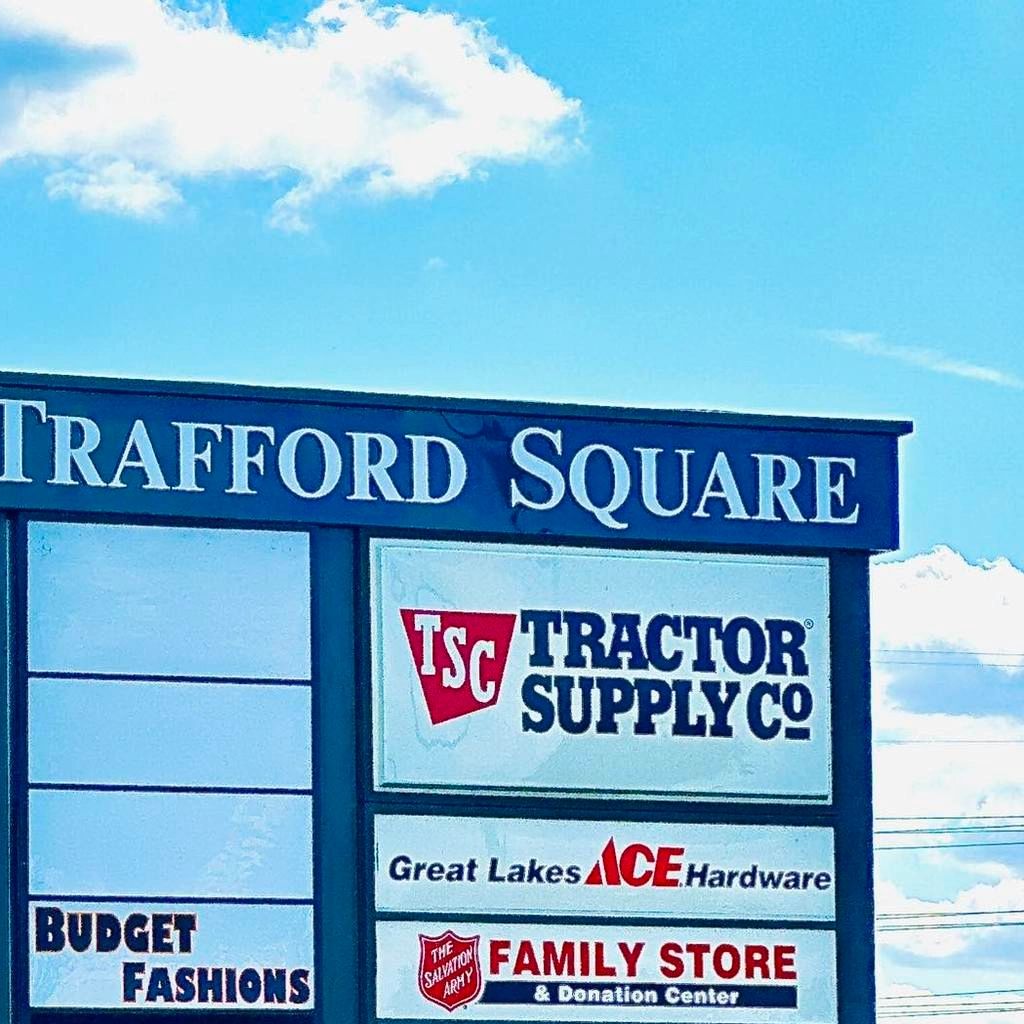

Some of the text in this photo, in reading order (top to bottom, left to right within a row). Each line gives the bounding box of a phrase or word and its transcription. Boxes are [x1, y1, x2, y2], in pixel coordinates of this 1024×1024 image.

[509, 426, 860, 531] SQUARE
[414, 613, 497, 703] TSC
[520, 608, 810, 677] TRACTOR
[521, 674, 740, 739] SUPPLY
[389, 836, 832, 890] Great Lakes ACE Hardware
[35, 907, 197, 953] BUDGET
[431, 941, 454, 963] THE
[424, 945, 473, 988] SALVATION
[489, 940, 798, 980] FAMILY STORE
[122, 962, 311, 1004] FASHIONS
[443, 967, 473, 999] ARMY
[534, 984, 740, 1006] & Donation Center
